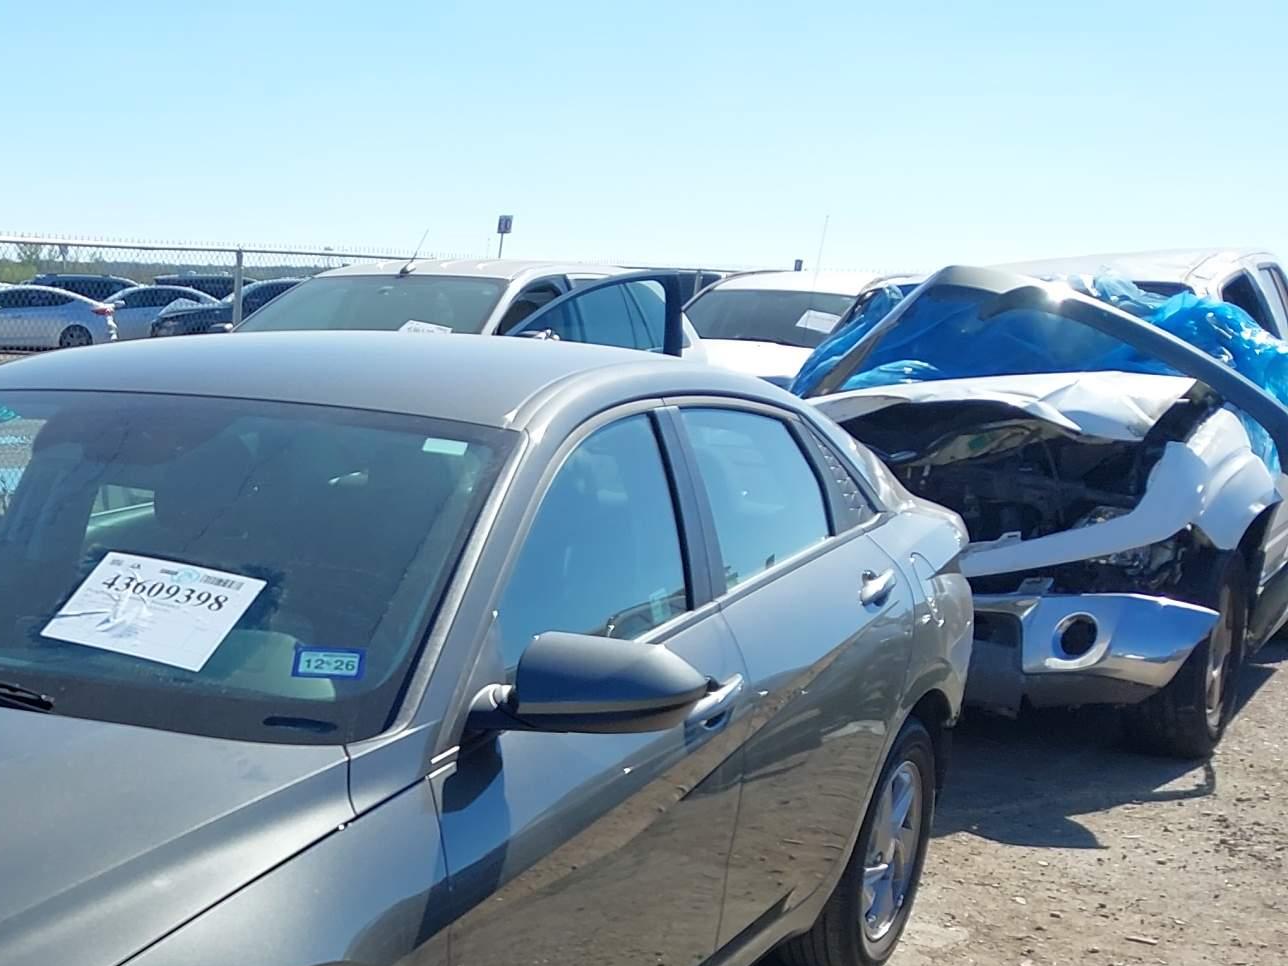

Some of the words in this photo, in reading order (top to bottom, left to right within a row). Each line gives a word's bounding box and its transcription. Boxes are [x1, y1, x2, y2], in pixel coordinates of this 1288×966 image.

[102, 574, 228, 611] 43609398
[304, 658, 325, 670] 12
[333, 659, 356, 672] 26
